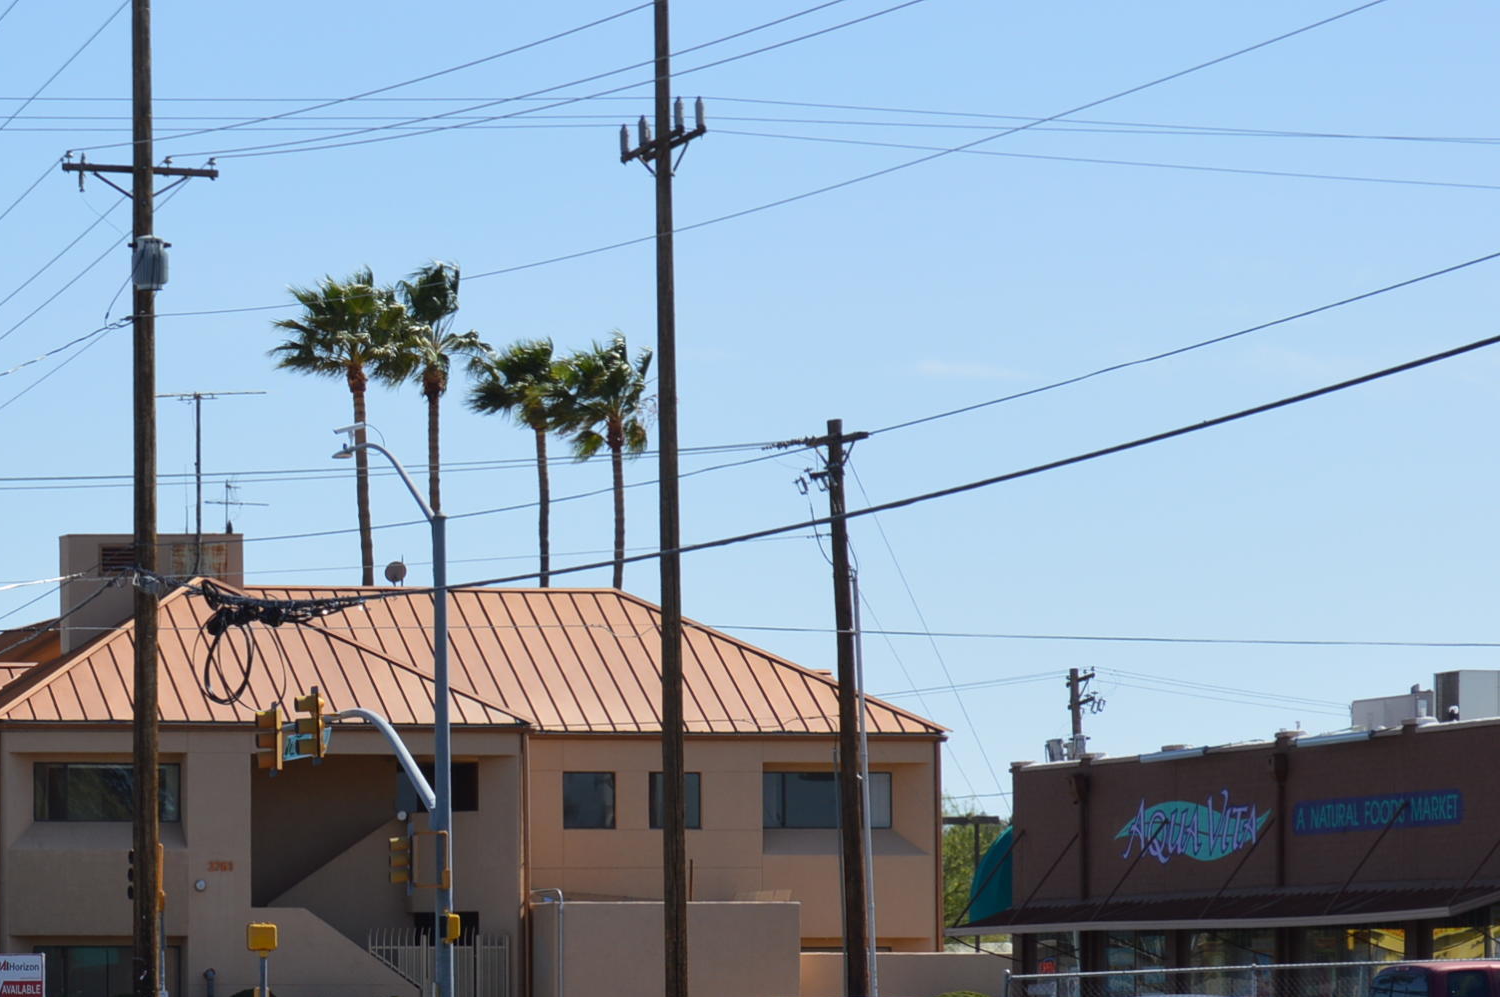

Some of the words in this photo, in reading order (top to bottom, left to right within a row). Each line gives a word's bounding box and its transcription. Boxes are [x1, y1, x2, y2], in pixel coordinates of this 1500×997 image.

[1296, 807, 1306, 831] A
[1310, 802, 1359, 829] NATURAL
[1410, 794, 1460, 822] MARKET
[1123, 798, 1202, 864] AQUA
[1207, 789, 1257, 857] VITA
[10, 962, 40, 972] Horizon
[1, 984, 41, 995] AVAILABLE
